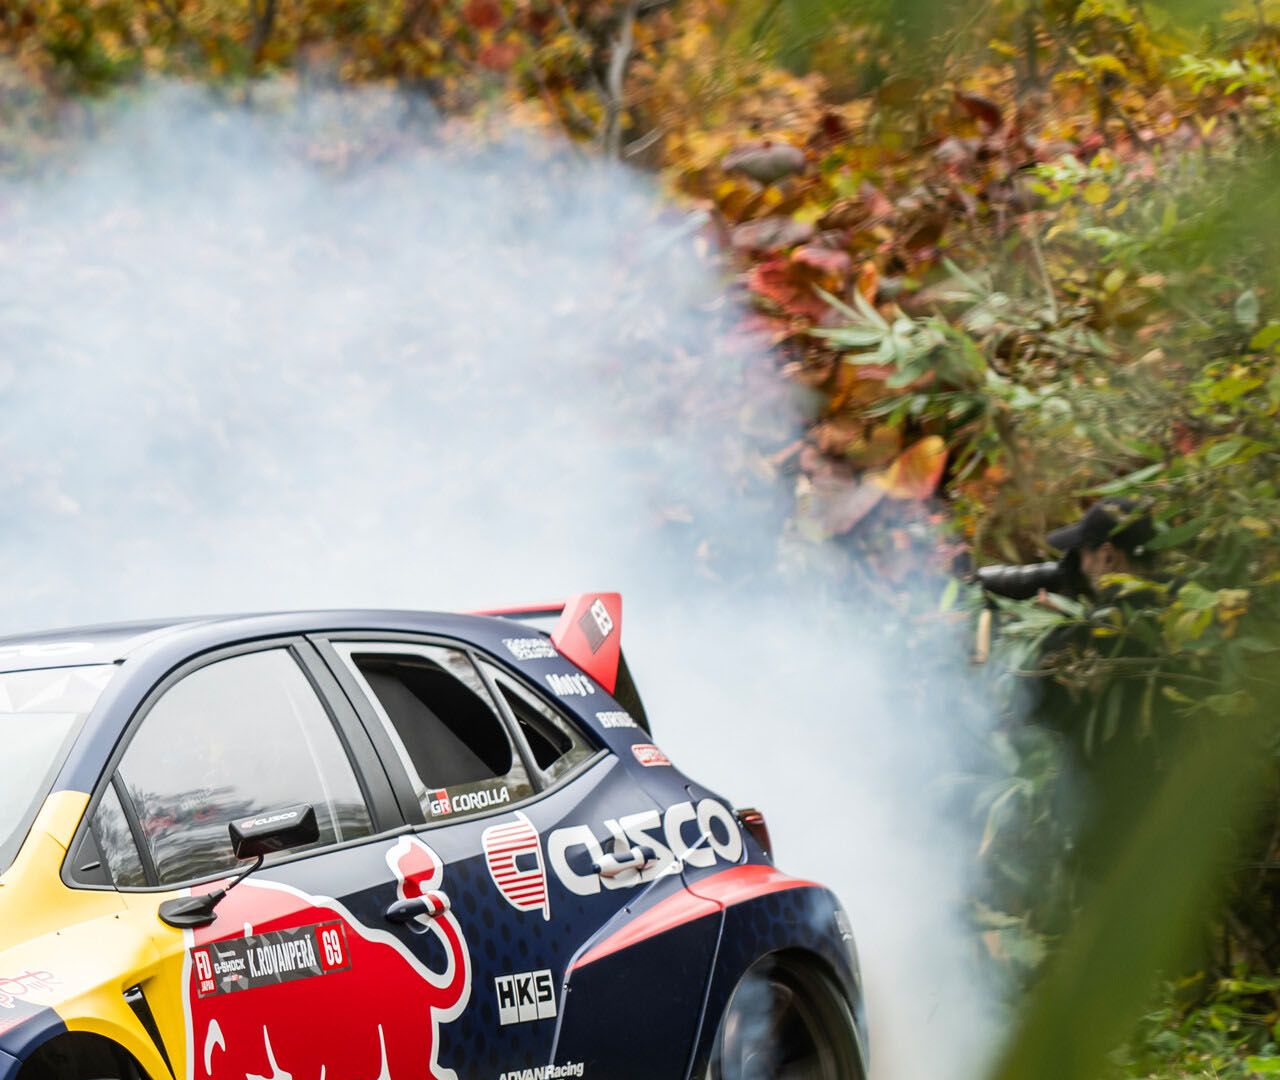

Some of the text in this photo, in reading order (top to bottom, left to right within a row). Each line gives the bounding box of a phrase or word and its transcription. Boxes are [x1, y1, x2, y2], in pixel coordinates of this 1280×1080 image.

[545, 673, 595, 697] Moty's
[431, 786, 510, 816] GR COROLLA
[254, 811, 299, 826] CUSCO
[548, 799, 742, 896] CUSCO
[247, 934, 318, 978] K.ROVANPERÄ
[322, 929, 343, 966] 69
[194, 950, 212, 980] FD
[214, 957, 246, 974] G-SHOCK
[497, 975, 553, 1009] HKS
